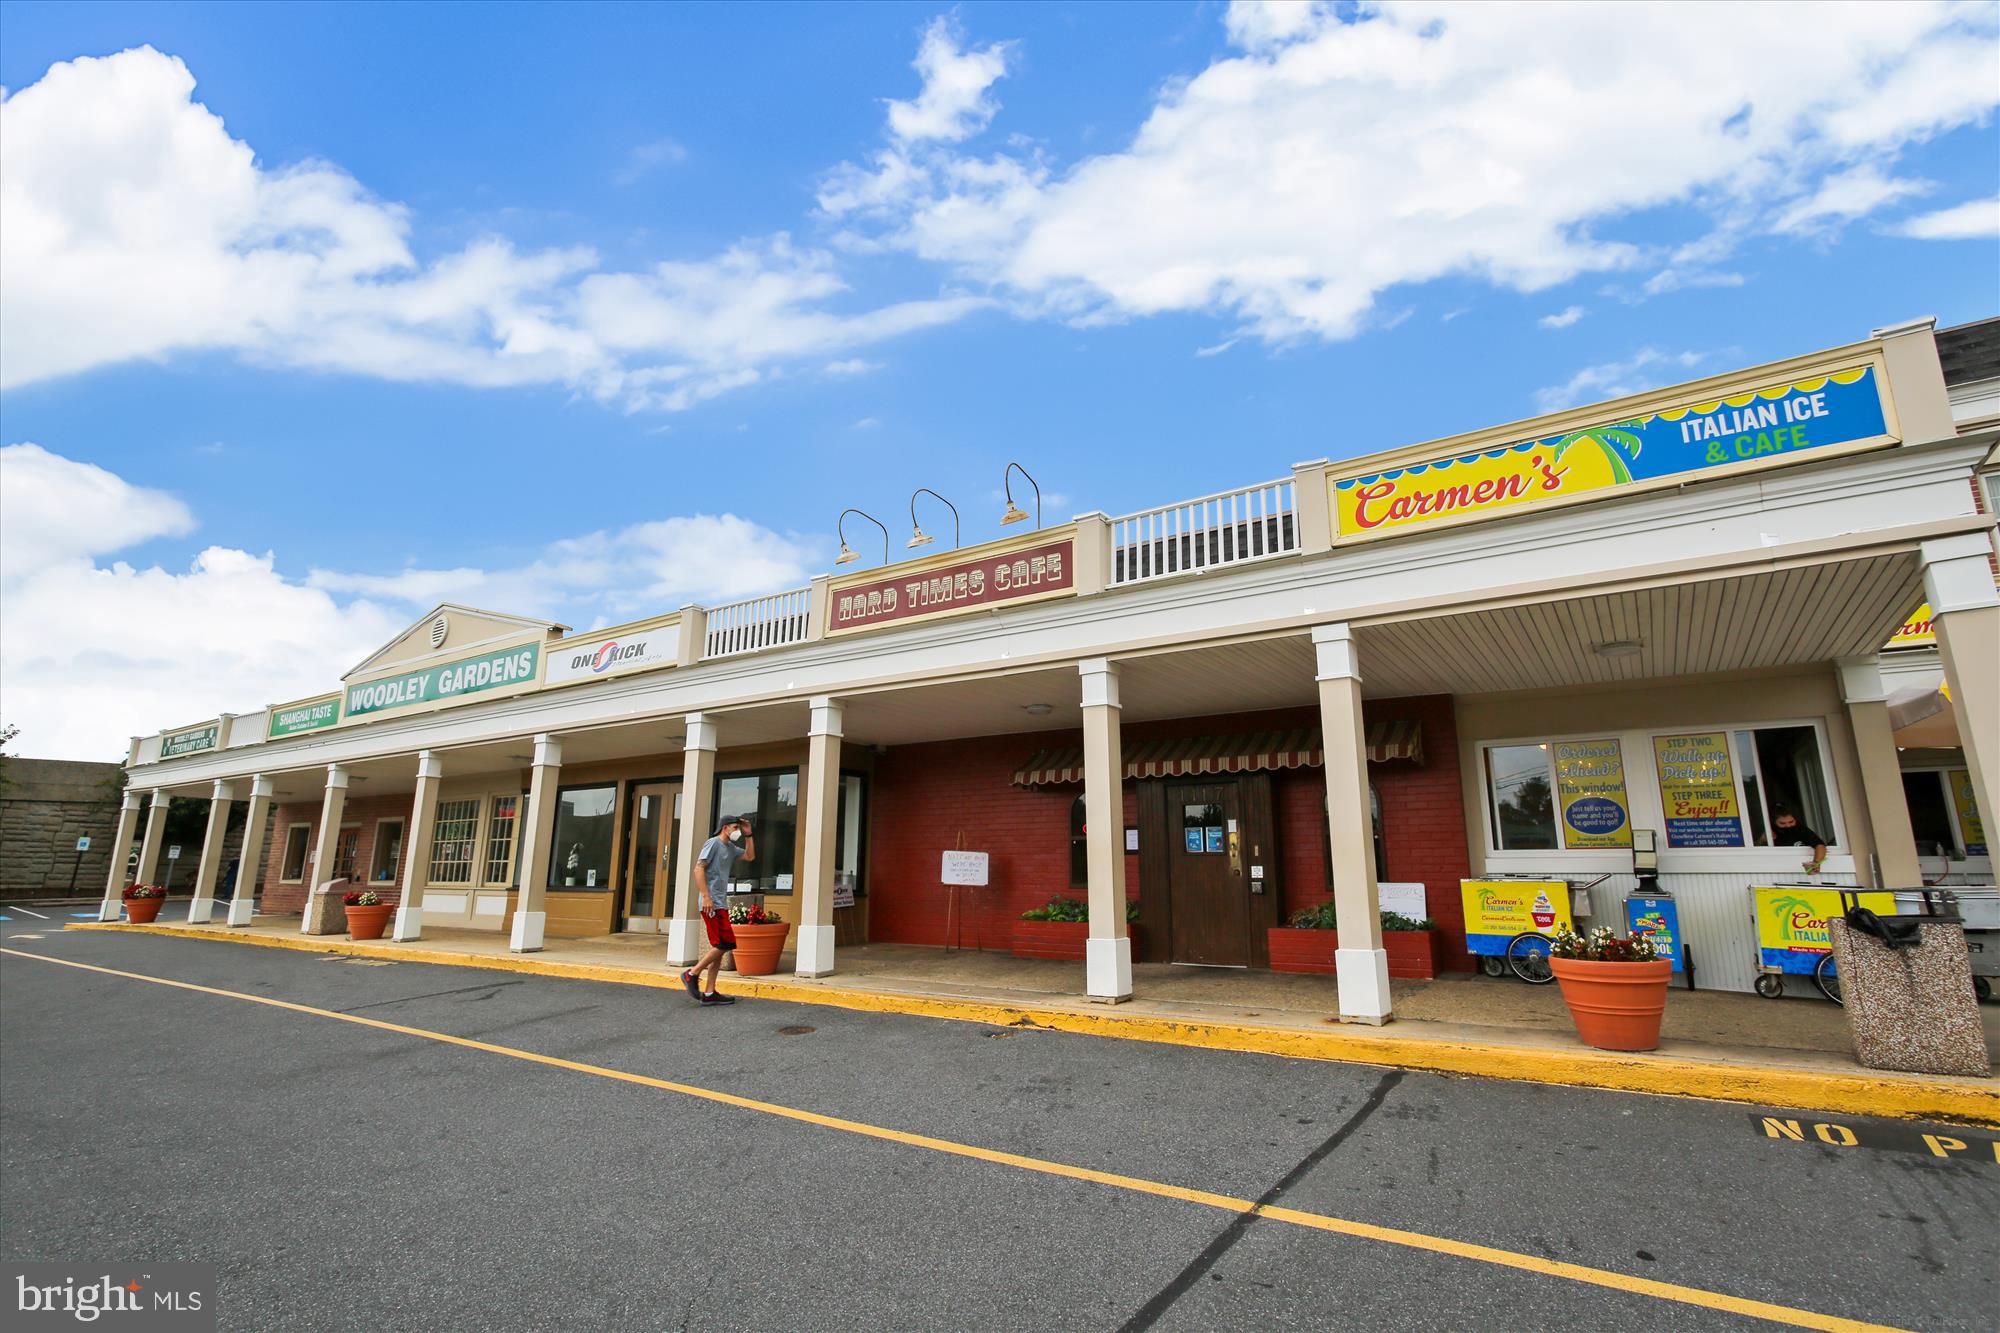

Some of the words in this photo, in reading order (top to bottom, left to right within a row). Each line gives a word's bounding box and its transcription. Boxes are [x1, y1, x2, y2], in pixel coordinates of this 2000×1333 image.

[1681, 403, 1777, 444] ITALIAN
[1783, 392, 1830, 420] ICE
[1705, 441, 1729, 464] &
[1734, 424, 1810, 458] CAFE
[1354, 454, 1571, 530] Carmen's
[838, 587, 898, 621] HARD
[905, 569, 985, 608] TIMES
[994, 552, 1062, 592] CAFE
[1896, 620, 1935, 637] rm
[571, 652, 600, 669] ONE
[608, 642, 647, 662] KICK
[351, 674, 431, 711] WOODLEY
[438, 651, 532, 694] GARDENS
[279, 709, 311, 727] SHANGHAI
[311, 704, 332, 720] TASTE
[168, 740, 195, 754] VETERINARY
[195, 737, 209, 750] CARE
[1558, 742, 1618, 758] Ordered
[1667, 738, 1689, 748] STEP
[1661, 749, 1703, 763] Walk
[1706, 751, 1726, 764] up
[1559, 761, 1621, 778] Ahead?
[1663, 765, 1696, 781] Pick
[1560, 783, 1581, 793] This
[1582, 781, 1625, 793] window!
[1672, 791, 1693, 801] STEP
[1674, 799, 1730, 818] Enjoy!!
[1485, 895, 1524, 905] Carmen's
[1761, 1116, 1860, 1147] NO
